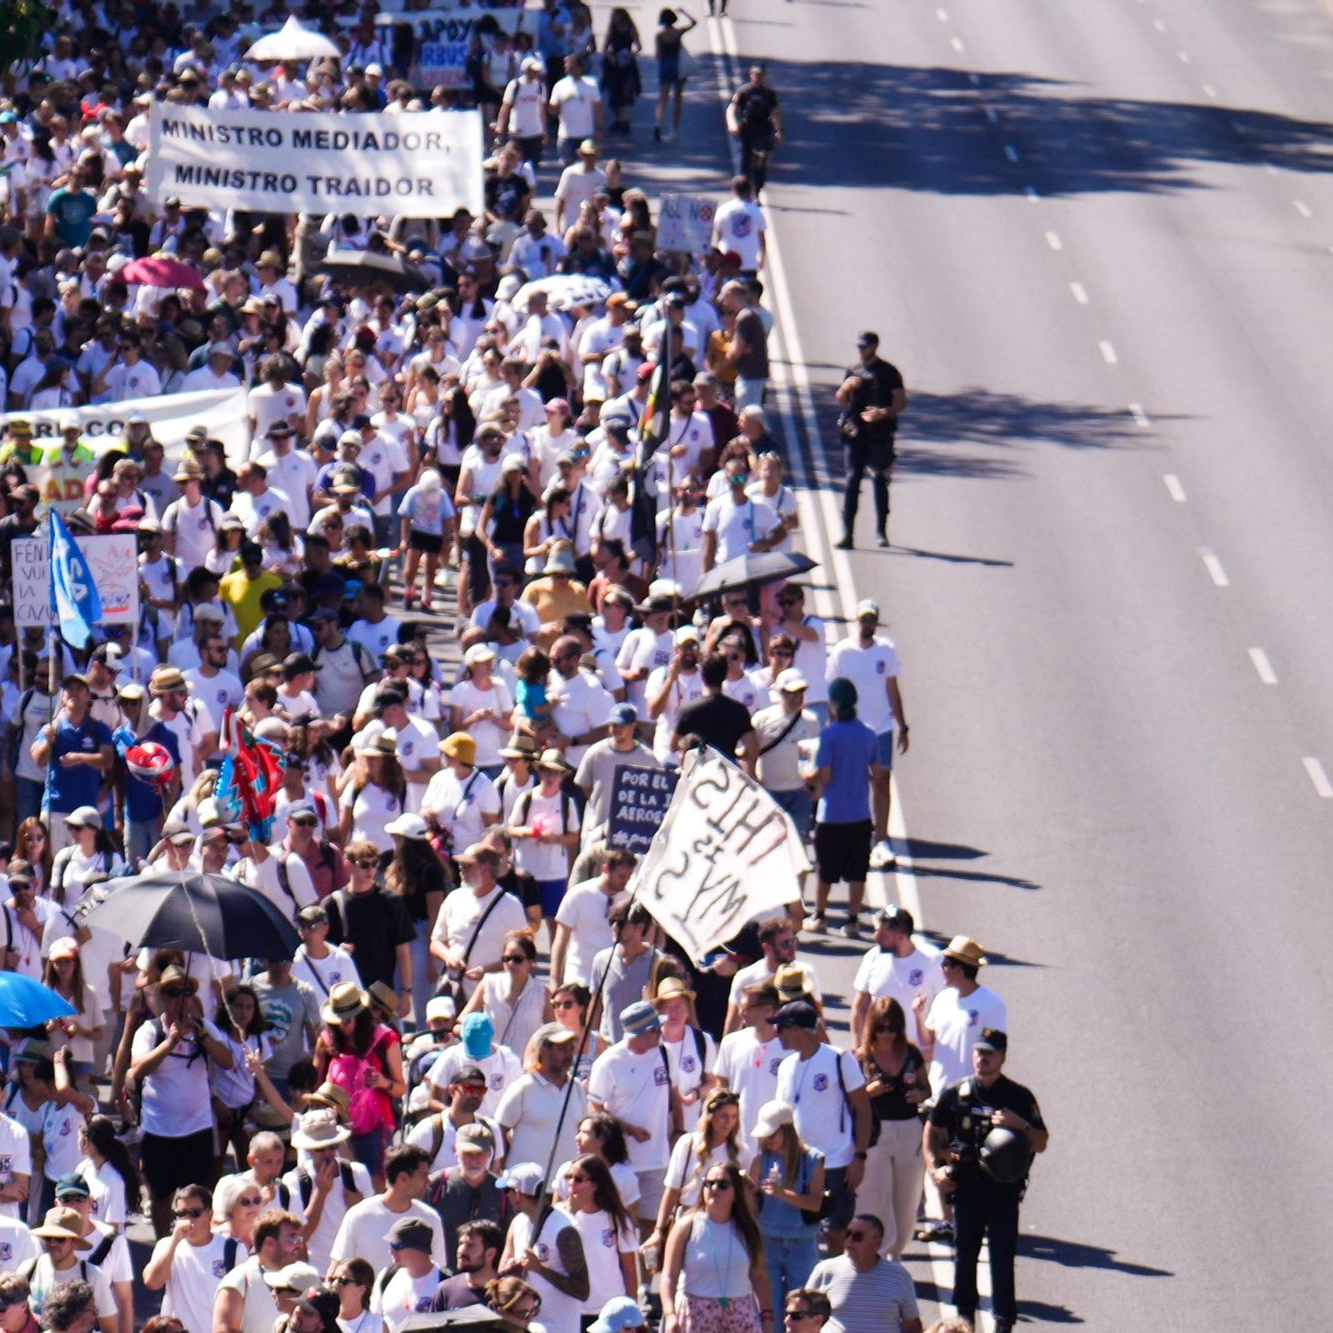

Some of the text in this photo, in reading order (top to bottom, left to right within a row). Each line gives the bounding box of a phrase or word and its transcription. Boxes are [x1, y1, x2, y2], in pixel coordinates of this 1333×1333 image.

[161, 117, 451, 155] MINISTRO MEDIADOR,
[175, 164, 435, 198] MINISTRO TRAIDOR
[621, 771, 669, 790] POR EL
[618, 789, 658, 806] DE LA
